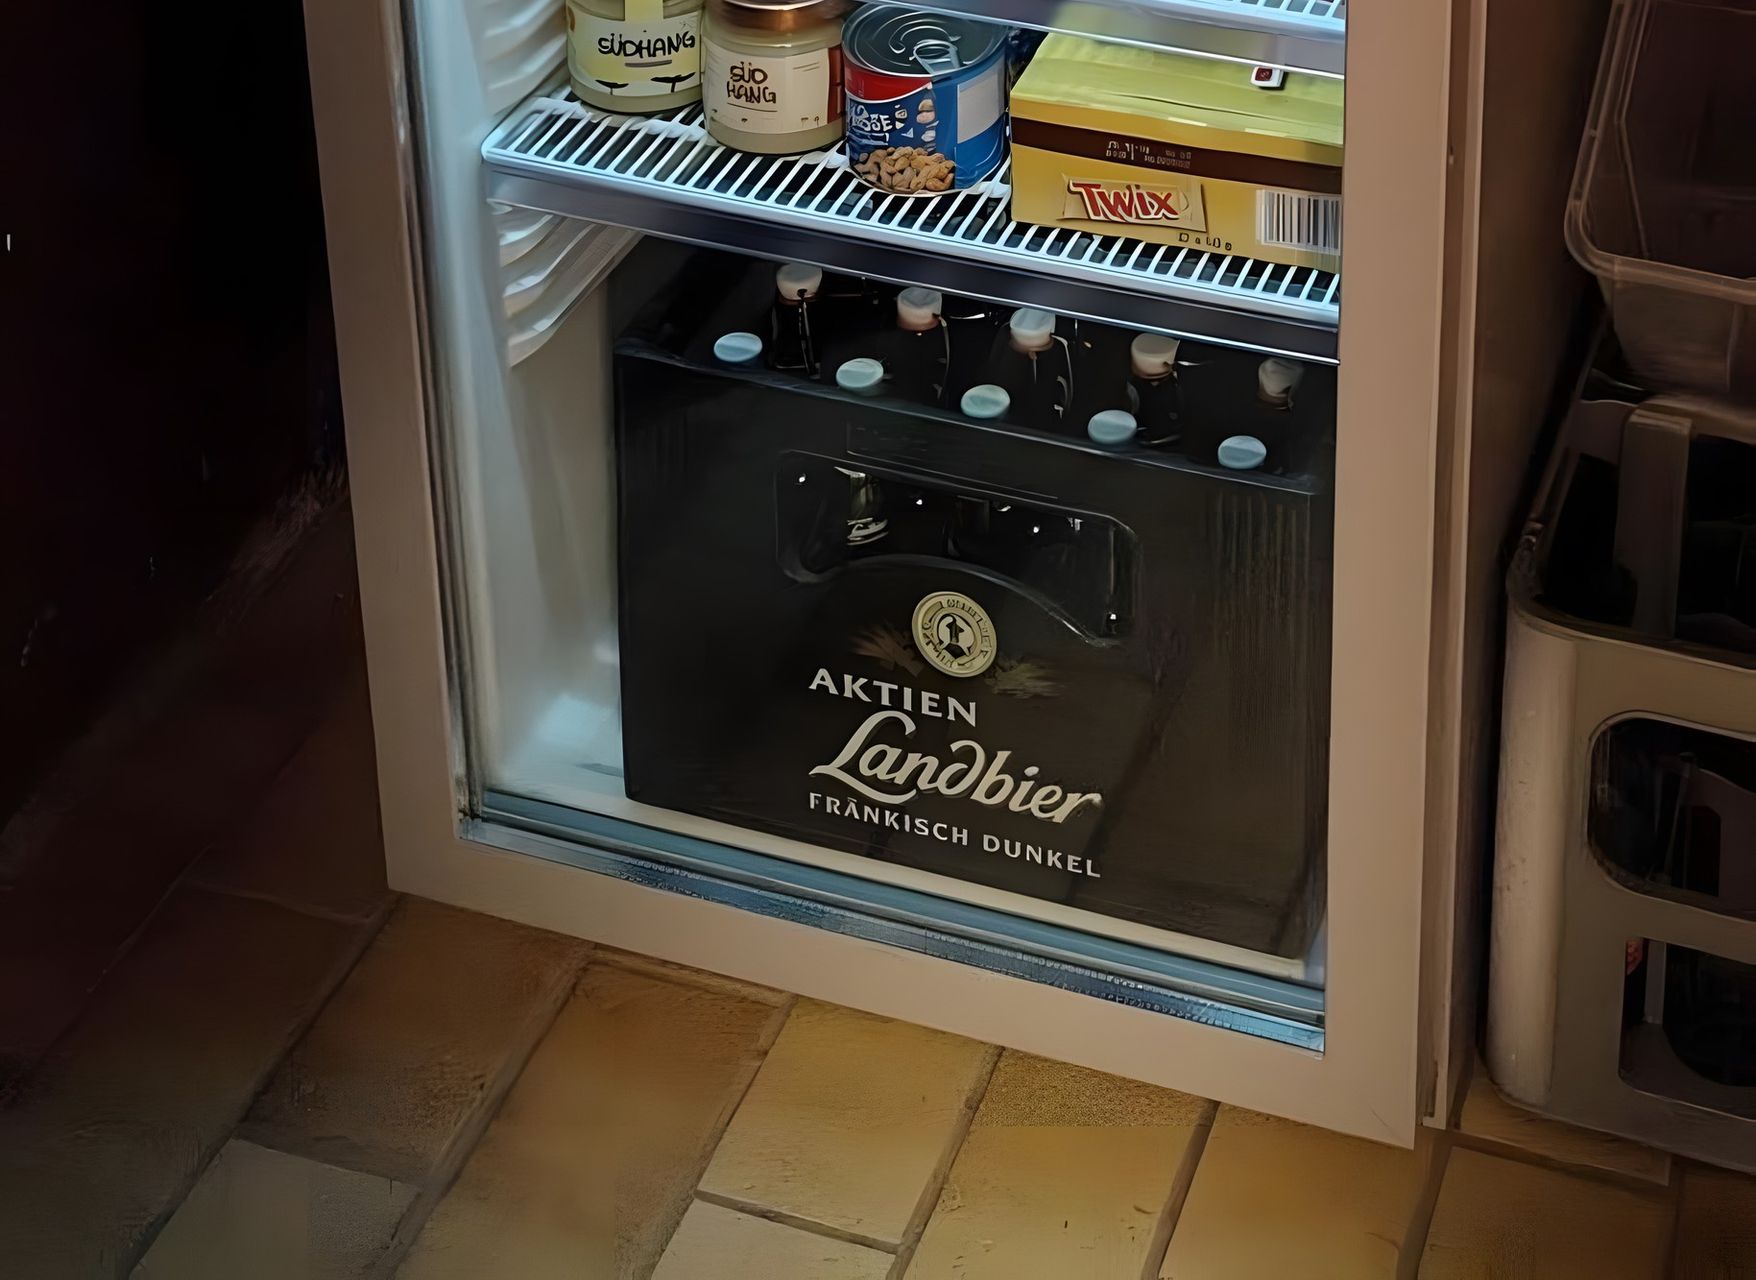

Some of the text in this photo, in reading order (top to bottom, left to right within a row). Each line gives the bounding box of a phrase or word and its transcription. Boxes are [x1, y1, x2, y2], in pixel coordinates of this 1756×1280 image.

[597, 30, 697, 59] SÜDHANG
[726, 84, 778, 105] HANG
[1067, 182, 1181, 223] Twix
[808, 667, 977, 728] AKTIEN
[808, 709, 1105, 824] Landbier
[808, 791, 1102, 879] FRÄNKISCH DUNKEL
